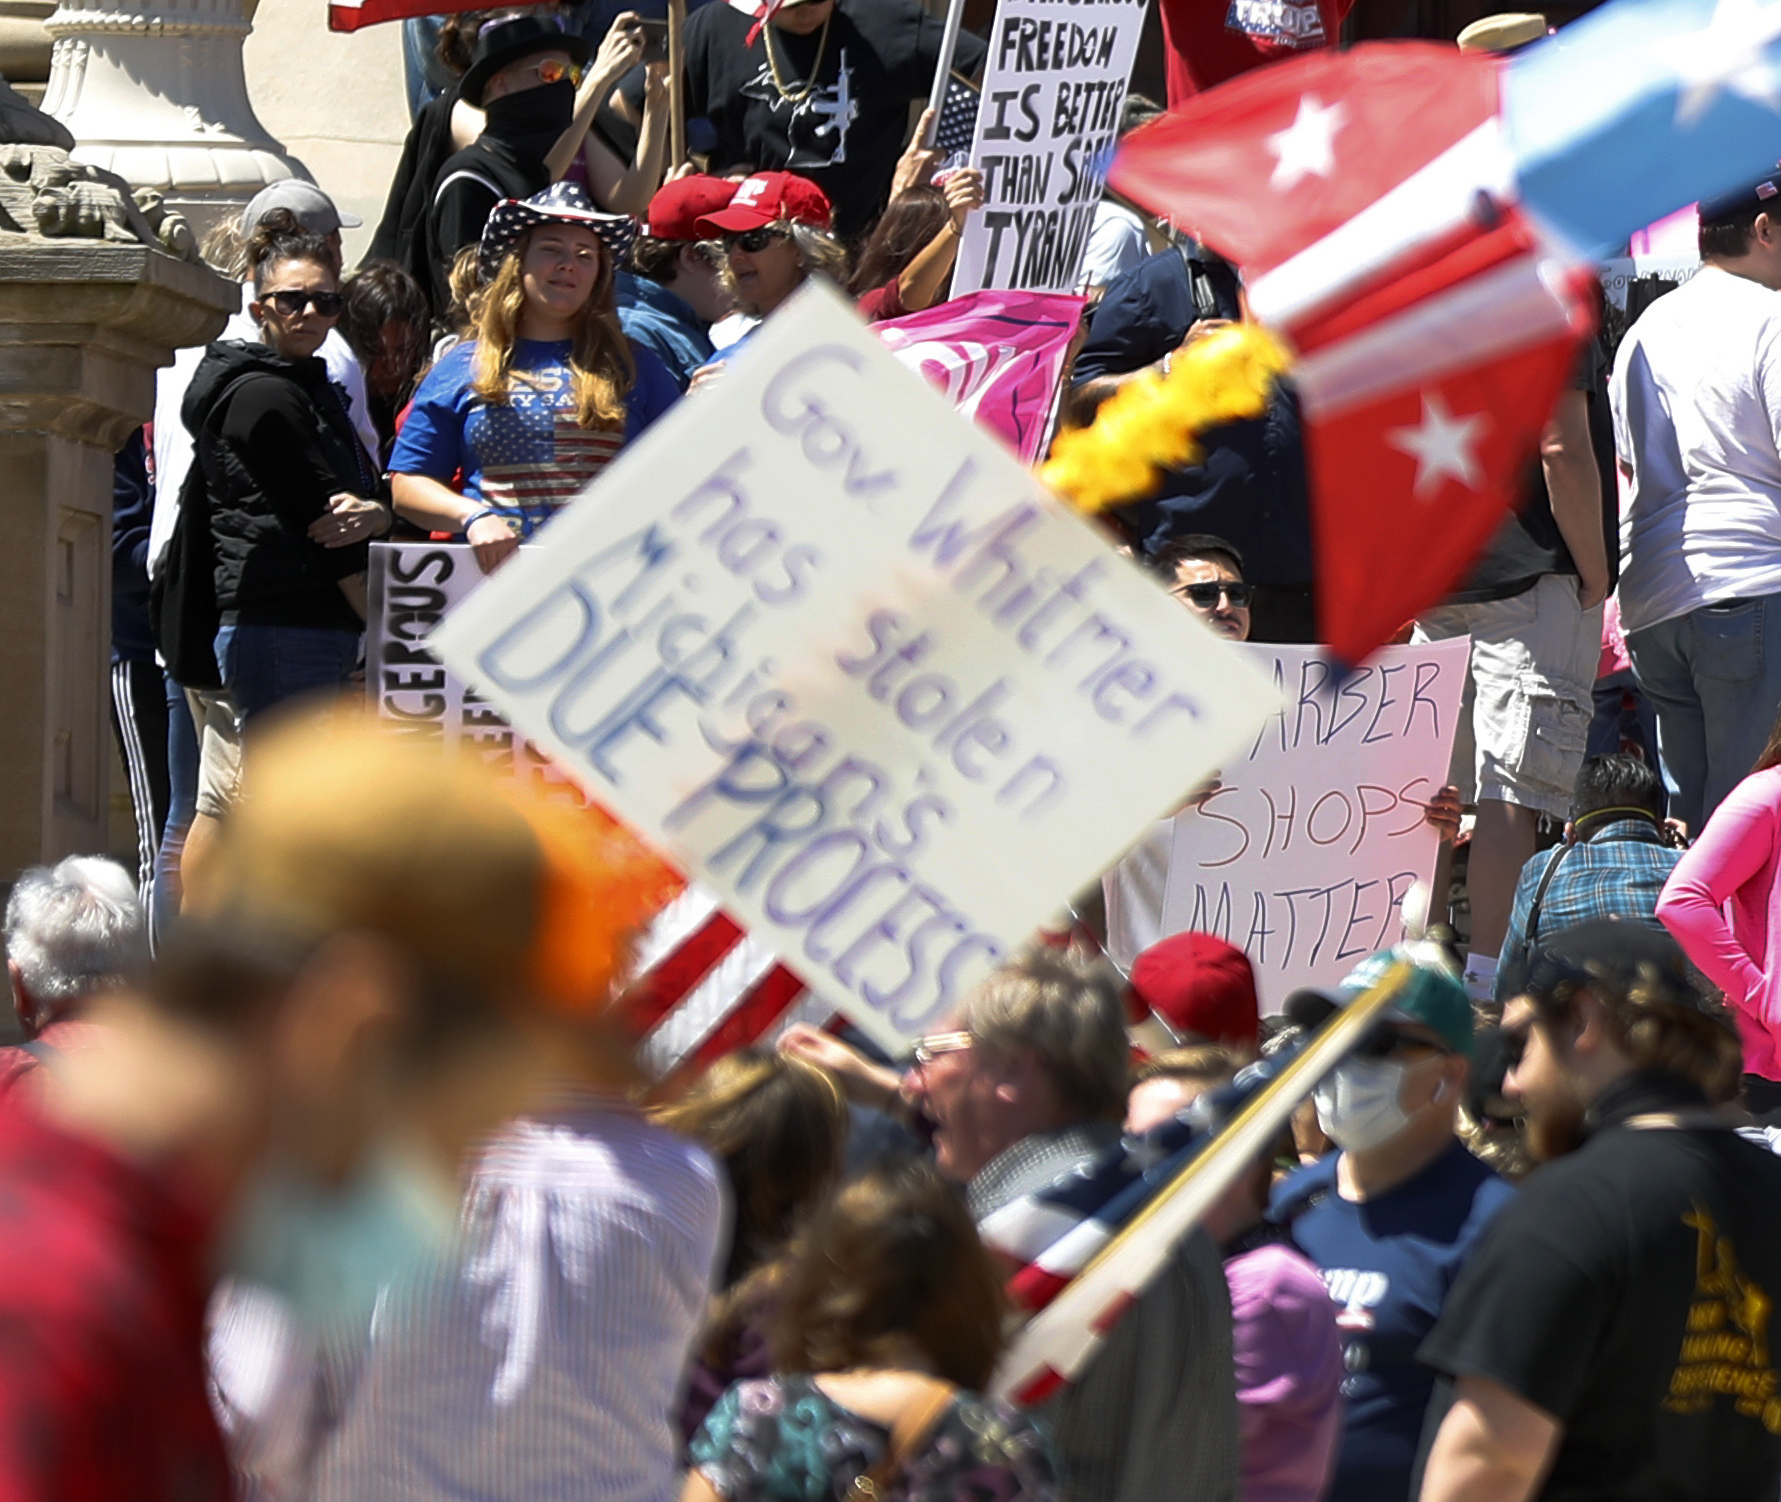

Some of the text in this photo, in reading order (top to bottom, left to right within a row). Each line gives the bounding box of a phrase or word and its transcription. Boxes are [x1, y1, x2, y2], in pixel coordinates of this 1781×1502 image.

[997, 16, 1118, 74] FREEDOM
[982, 75, 1126, 143] IS BETTER
[979, 150, 1054, 205] THAN
[669, 443, 1068, 823] has stolen
[1248, 656, 1441, 762] ARBER
[474, 580, 1006, 1035] DUE PROCESS
[1196, 776, 1432, 867] SHOPS
